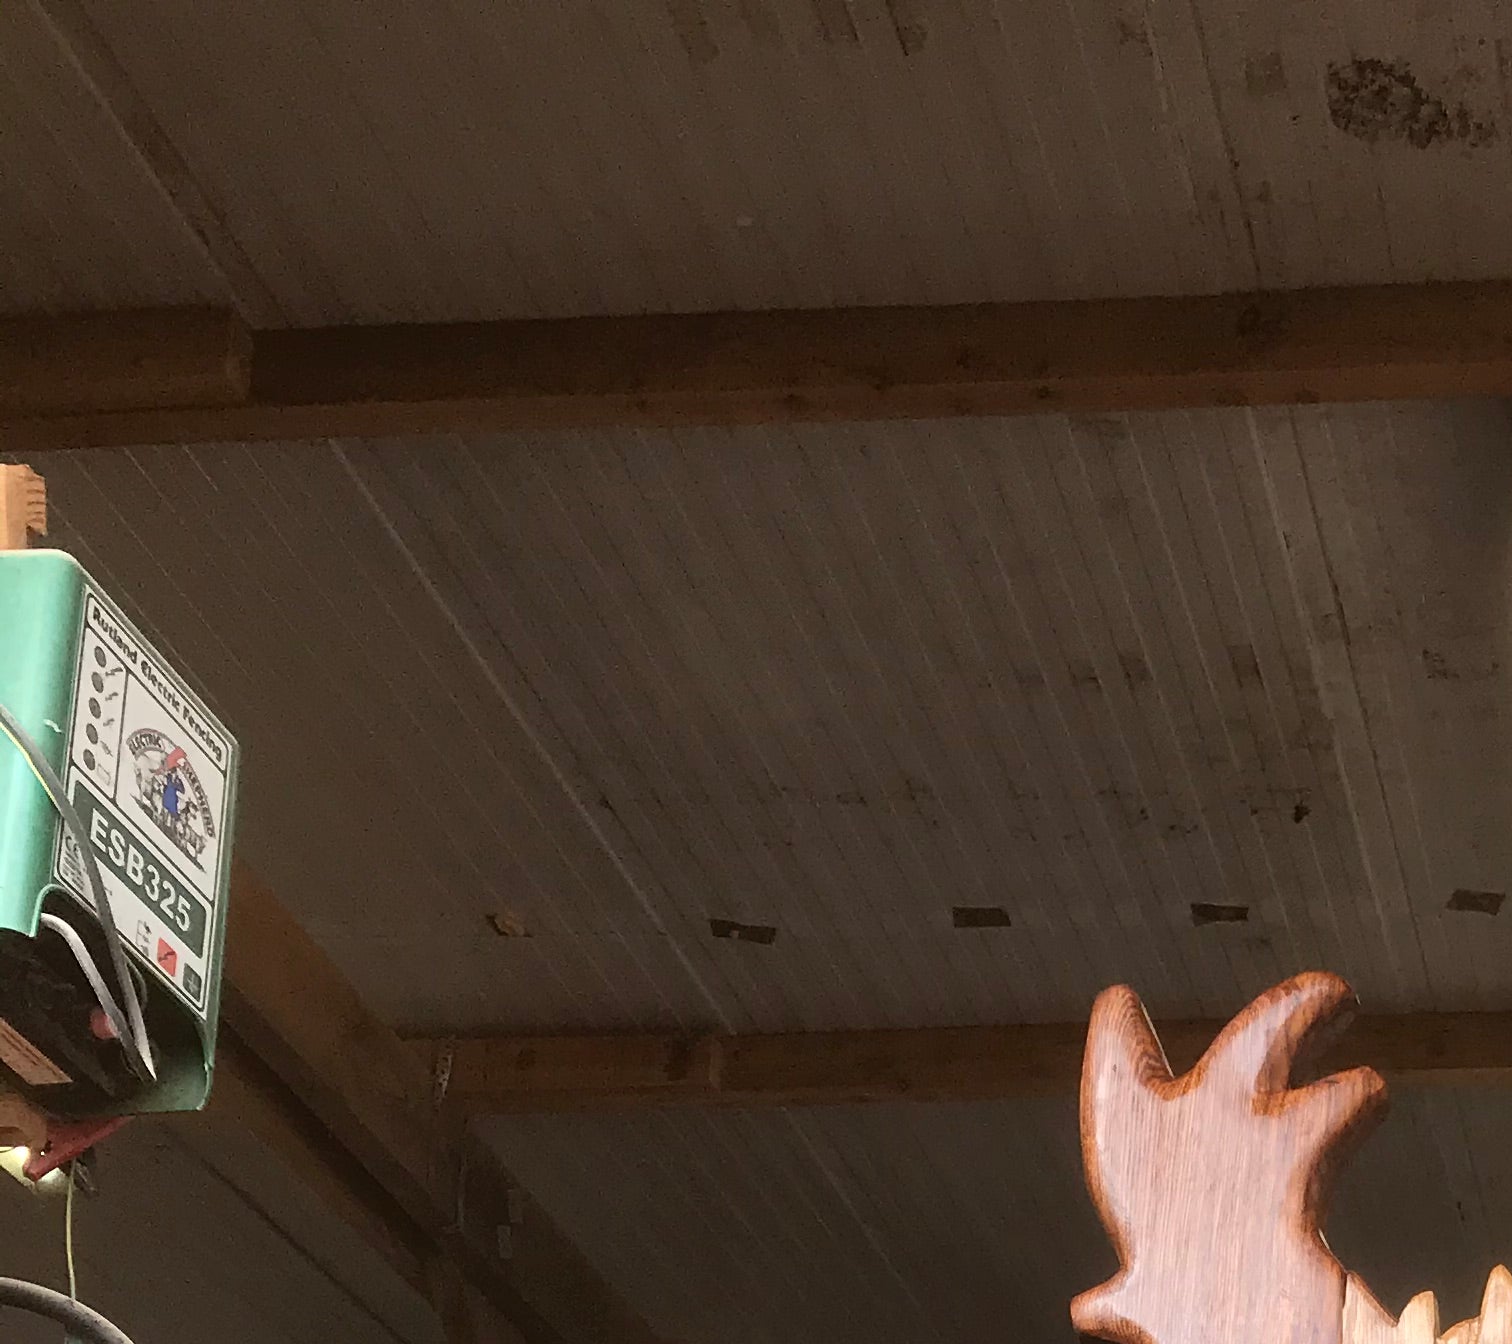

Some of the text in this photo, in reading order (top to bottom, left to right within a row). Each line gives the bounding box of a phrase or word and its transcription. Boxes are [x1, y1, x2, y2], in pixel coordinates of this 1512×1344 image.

[92, 605, 222, 762] Rutland Electric Fencing
[90, 807, 191, 932] ESB325
